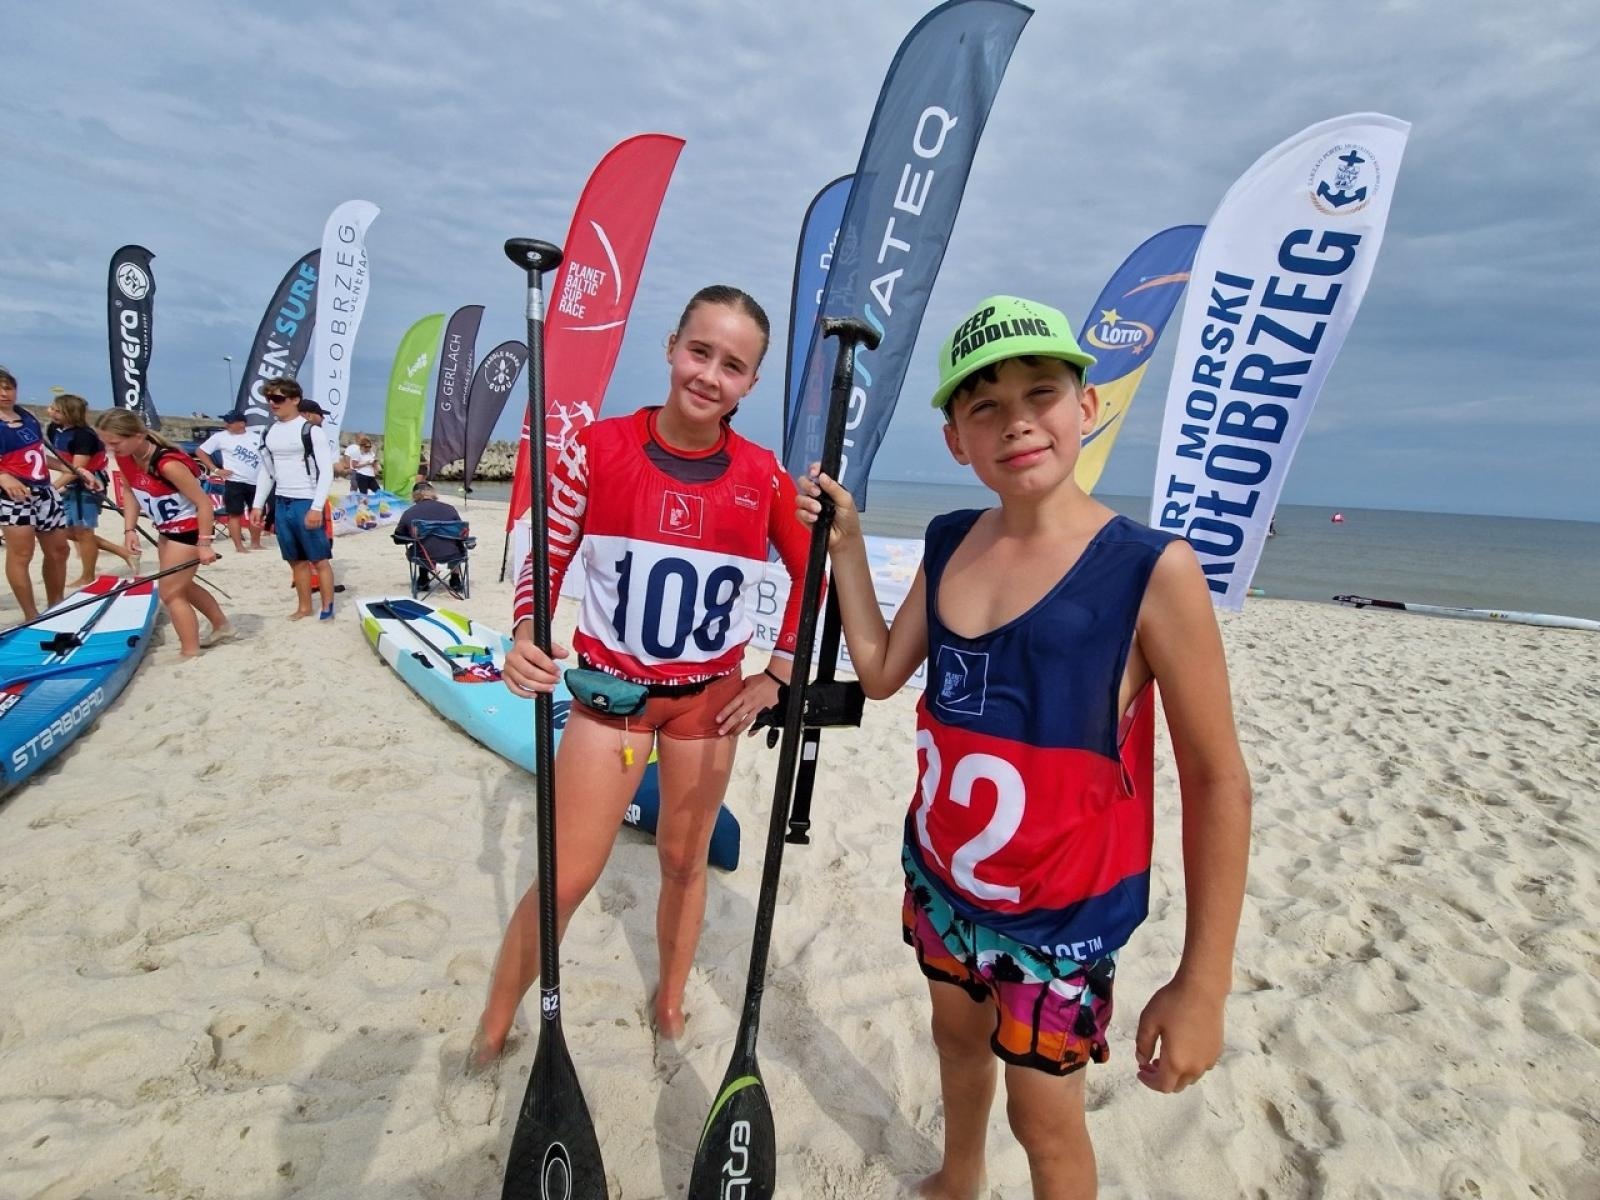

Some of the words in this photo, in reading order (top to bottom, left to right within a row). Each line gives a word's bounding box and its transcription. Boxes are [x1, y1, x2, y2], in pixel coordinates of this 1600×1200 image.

[562, 287, 582, 303] SUP
[565, 274, 599, 296] BALTIC
[569, 261, 607, 285] PLANET
[275, 262, 318, 338] SURF
[558, 300, 586, 320] RACE
[952, 305, 996, 350] KEEP
[1100, 324, 1143, 344] LOTTO
[443, 334, 462, 396] GERLACH
[1176, 269, 1255, 461] MORSKI
[1160, 474, 1196, 529] RT
[613, 551, 744, 659] 108
